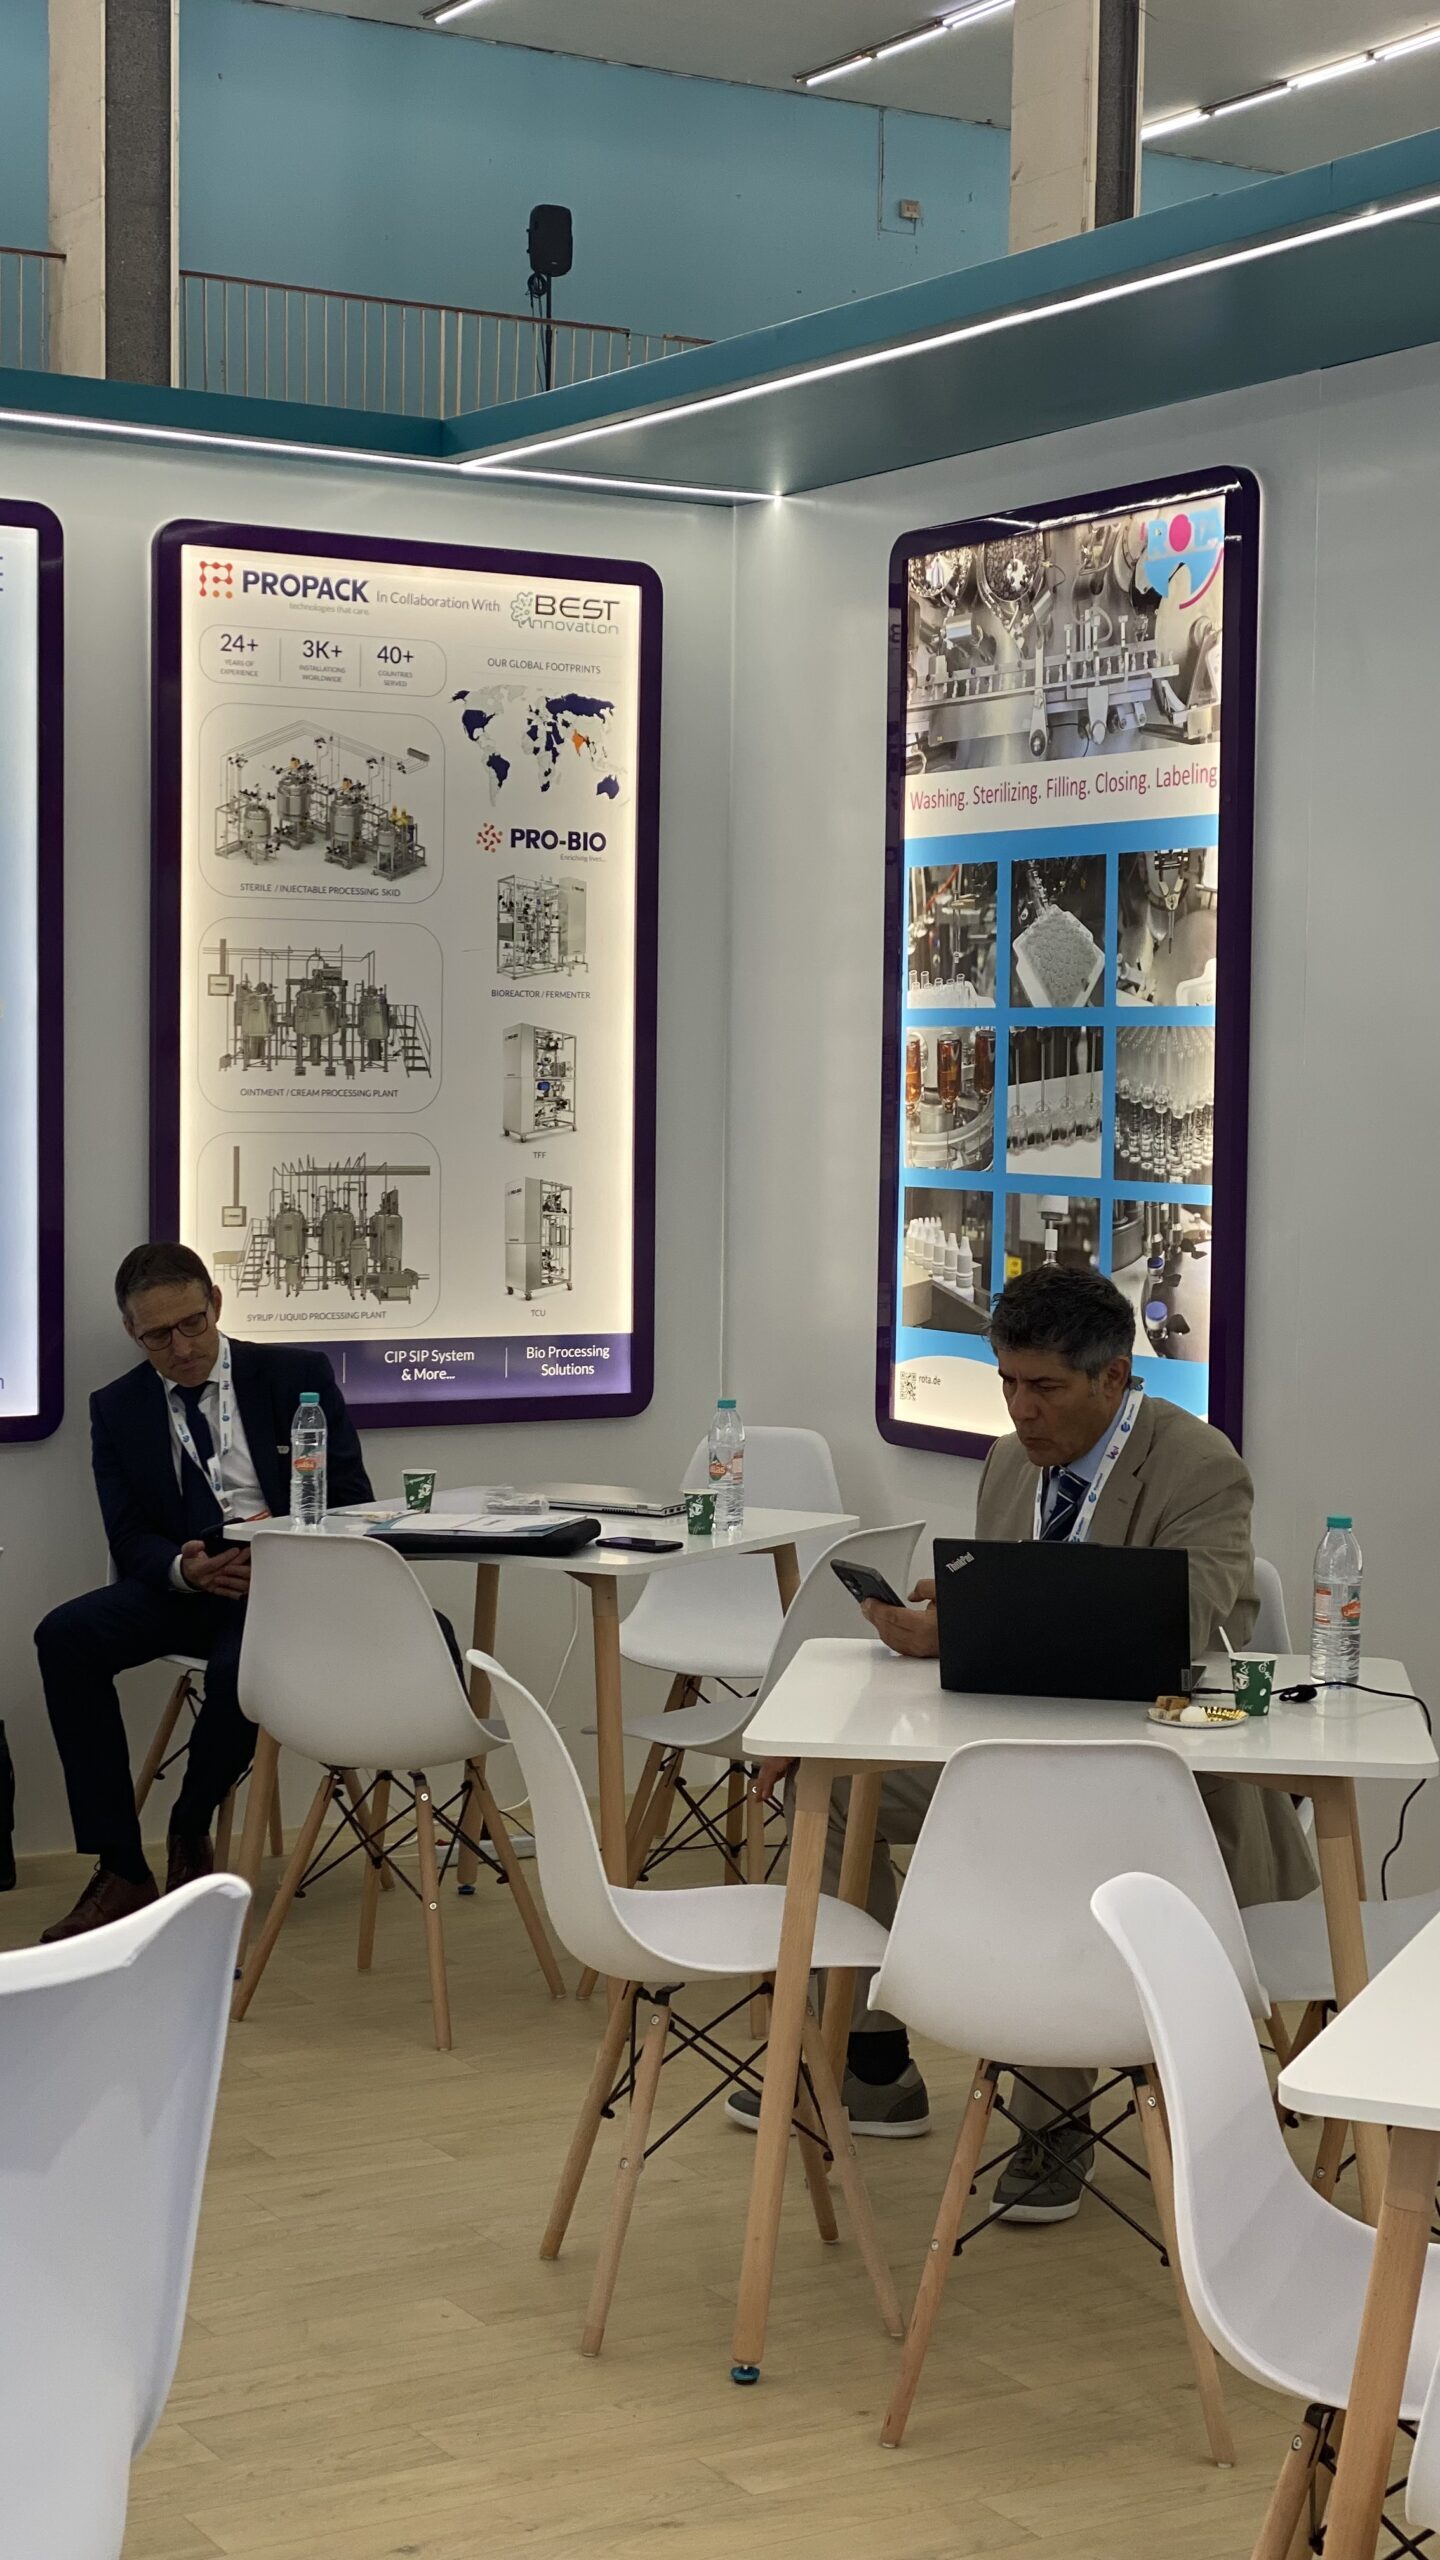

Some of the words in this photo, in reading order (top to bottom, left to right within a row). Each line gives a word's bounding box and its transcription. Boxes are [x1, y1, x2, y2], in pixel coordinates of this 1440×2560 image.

[242, 570, 370, 603] PROPACK
[376, 590, 388, 603] In
[390, 591, 469, 610] Collaboration
[471, 598, 501, 612] With
[535, 594, 620, 621] BEST
[220, 633, 259, 653] 24+
[302, 639, 342, 660] 3K+
[376, 645, 415, 664] 40+
[487, 658, 508, 668] OUR
[509, 659, 544, 670] GLOBAL
[545, 662, 601, 674] FOOTPRINTS
[910, 787, 969, 811] Washing.
[973, 781, 1042, 804] Sterilizing.
[1046, 776, 1091, 800] Filling.
[1095, 770, 1151, 795] Closing.
[1156, 762, 1218, 788] Labeling
[510, 828, 607, 852] PRO-BIO
[240, 883, 272, 892] STERILE
[280, 884, 327, 894] INJECTABLE
[328, 886, 379, 896] PROCESSING
[381, 888, 401, 897] SKID
[491, 989, 540, 998] BIOREACTOR
[546, 990, 591, 999] FERMENTER
[240, 1088, 284, 1097] OINTMENT
[290, 1089, 320, 1097] CREAM
[321, 1089, 372, 1098] PROCESSING
[372, 1089, 399, 1098] PLANT
[533, 1151, 547, 1159] TFF
[247, 1313, 273, 1322] SYRUP
[279, 1313, 308, 1321] LIQUID
[309, 1312, 360, 1320] PROCESSING
[360, 1311, 387, 1319] PLANT
[531, 1309, 546, 1317] TCU
[384, 1350, 408, 1364] CIP
[409, 1350, 430, 1363] SIP
[431, 1350, 475, 1365] System
[526, 1346, 546, 1359] Bio
[548, 1345, 610, 1360] Processing
[401, 1369, 412, 1381] &
[414, 1368, 456, 1381] More...
[541, 1363, 595, 1377] Solutions
